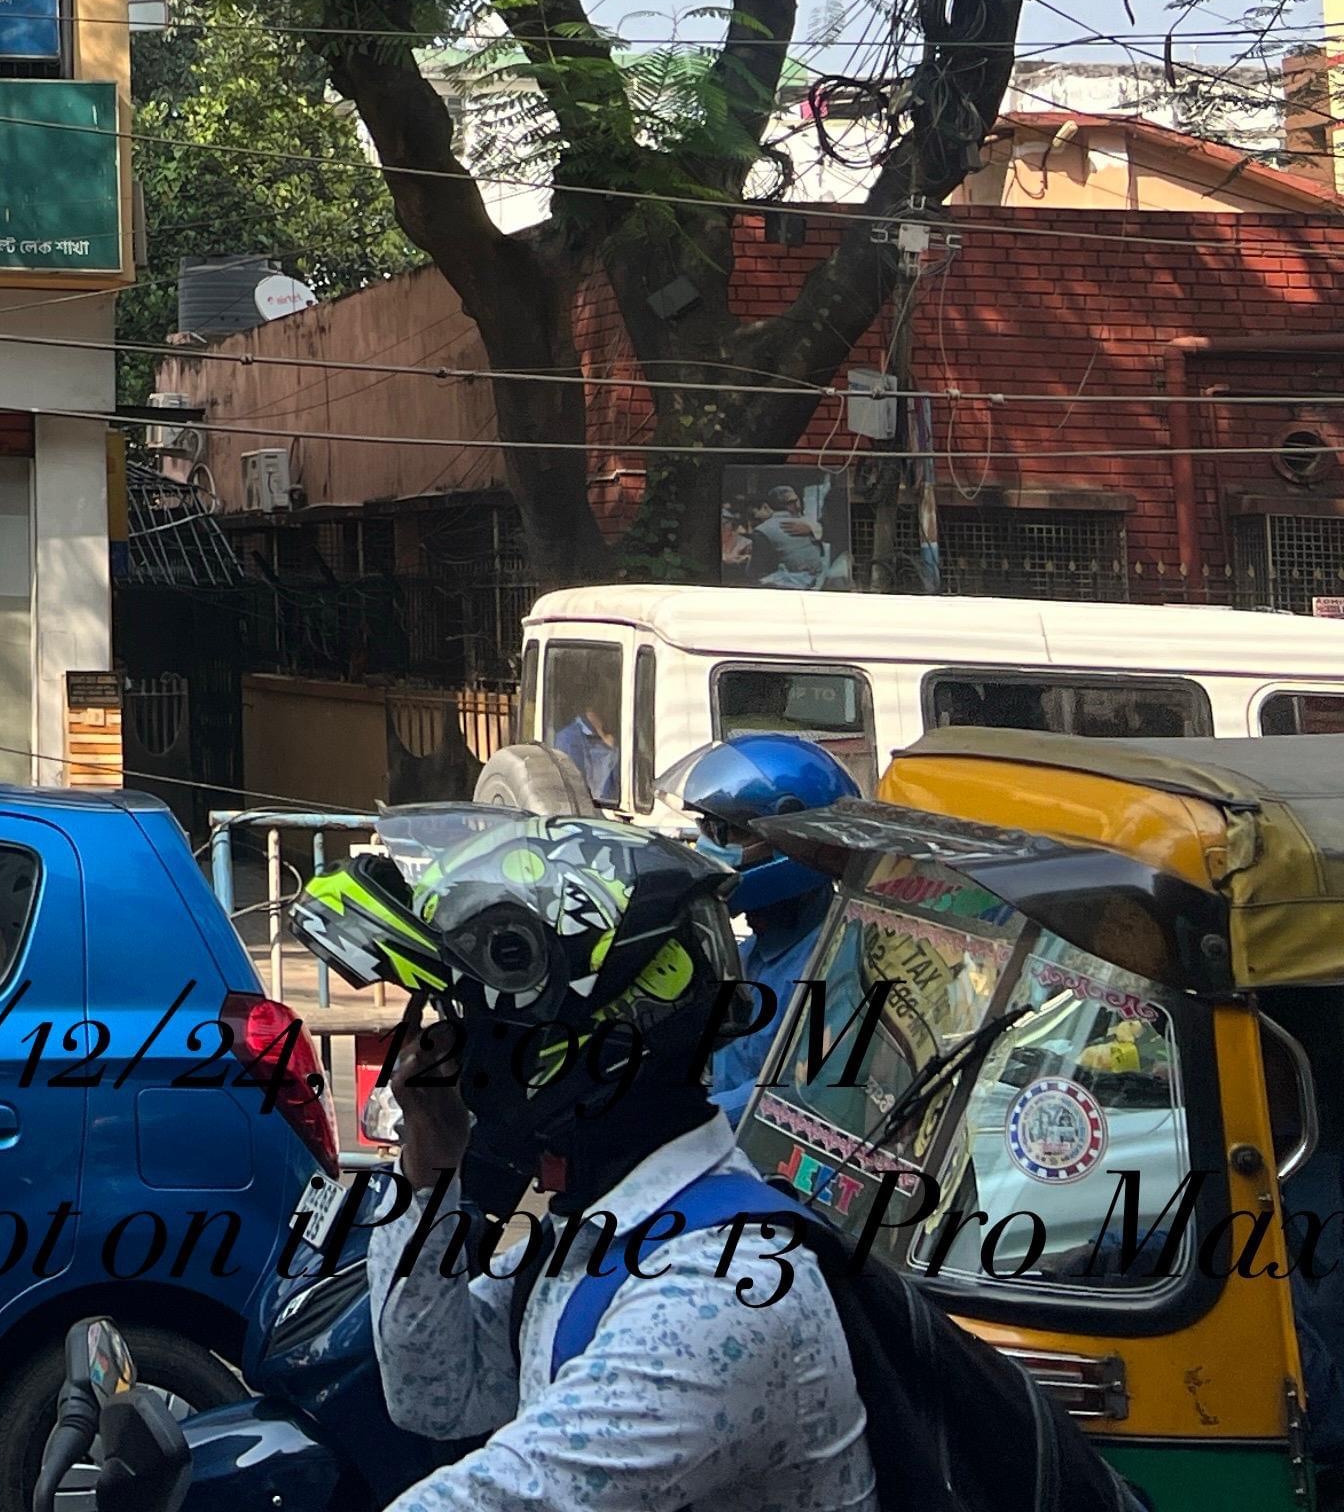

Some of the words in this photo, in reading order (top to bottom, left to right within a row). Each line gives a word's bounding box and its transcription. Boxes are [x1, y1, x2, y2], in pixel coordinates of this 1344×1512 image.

[20, 238, 52, 255] লেক
[55, 239, 90, 256] শাখা
[777, 1144, 864, 1216] JEET
